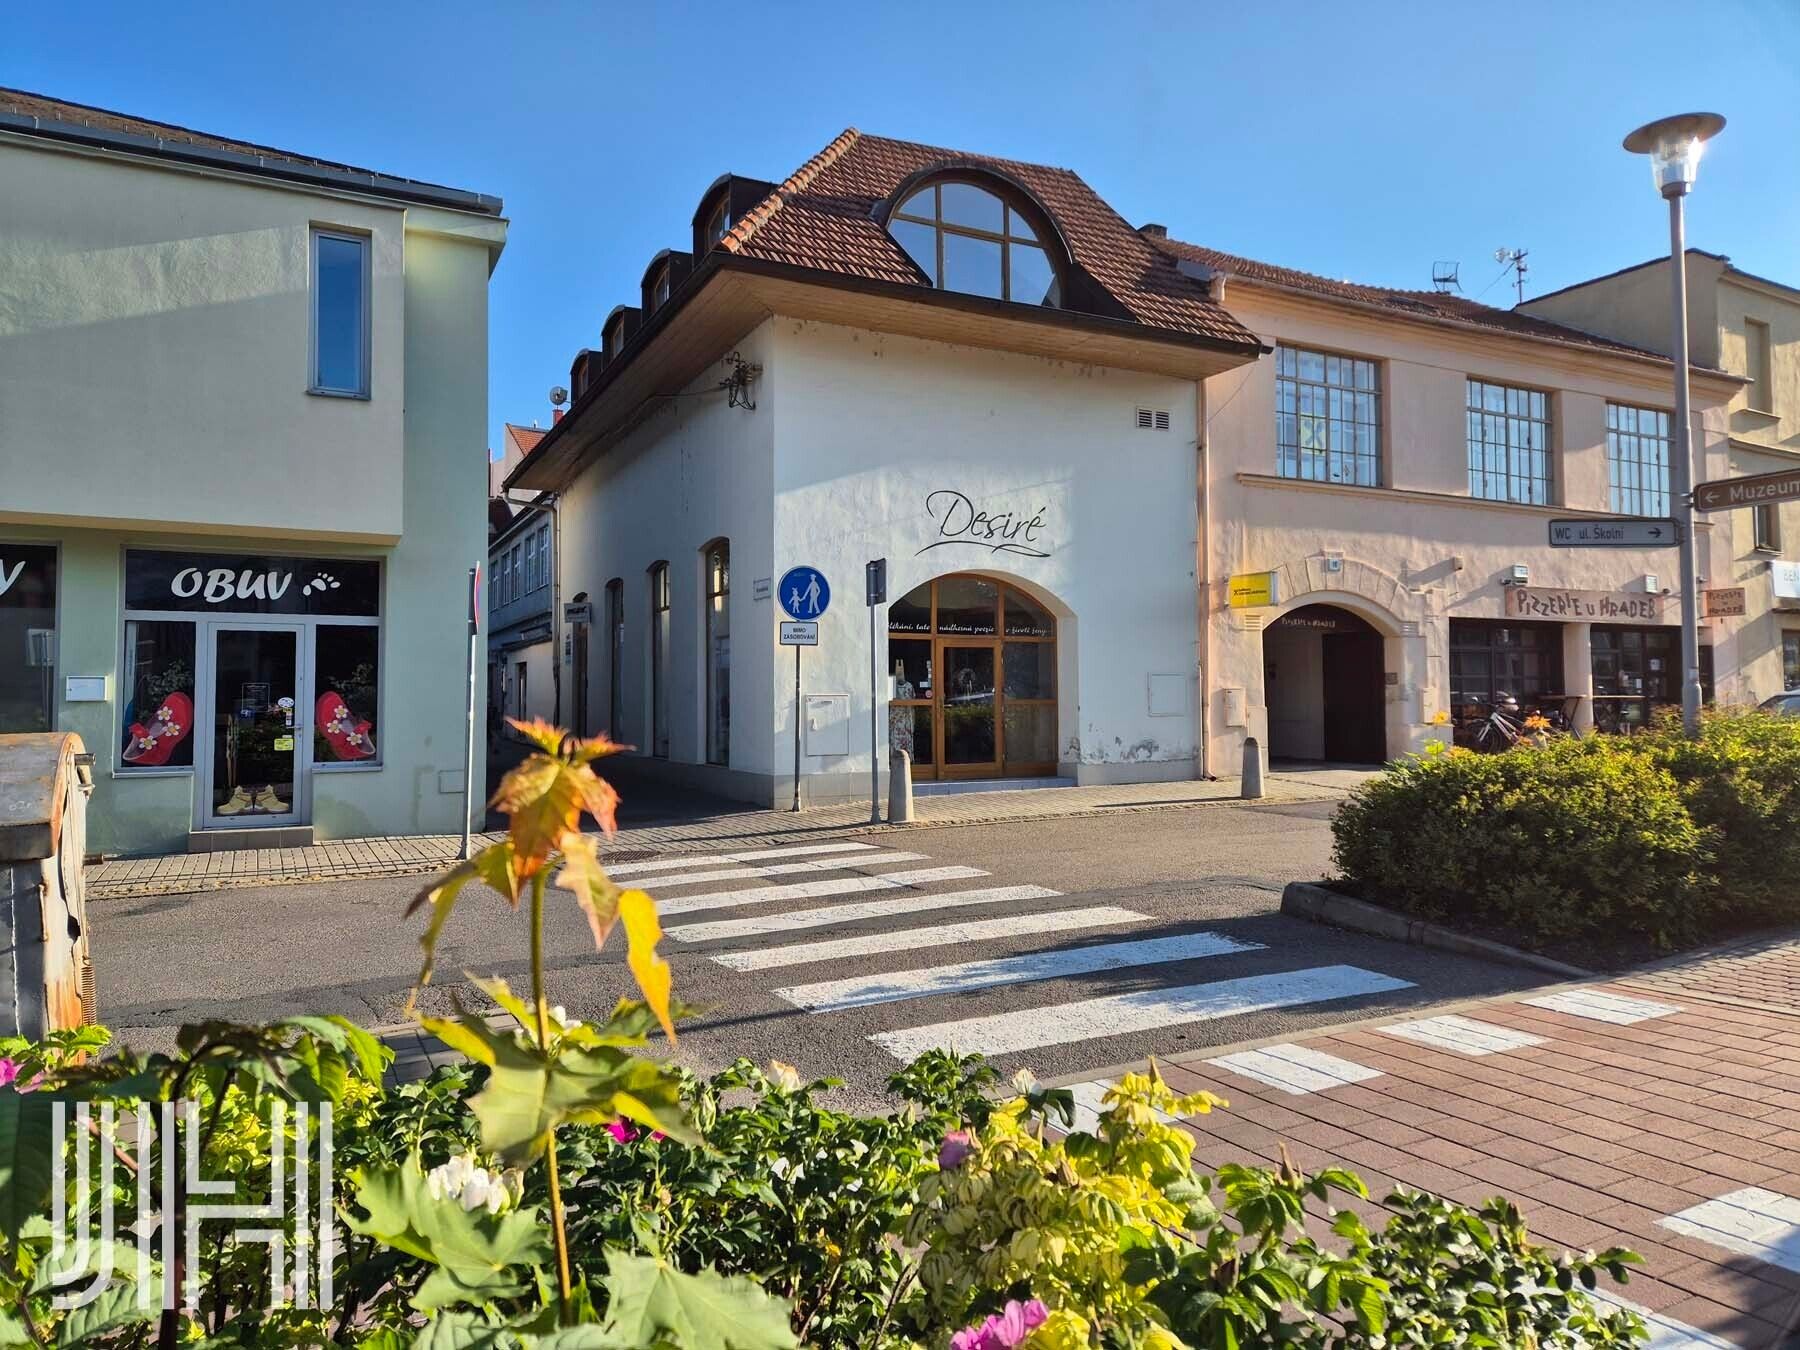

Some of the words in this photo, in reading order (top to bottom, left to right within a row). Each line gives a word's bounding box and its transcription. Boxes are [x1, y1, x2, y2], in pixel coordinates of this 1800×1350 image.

[926, 490, 1047, 542] Desiré
[1554, 527, 1571, 540] WC
[1579, 527, 1592, 540] ul.
[1593, 523, 1625, 540] Školní
[170, 567, 293, 604] OBUV
[1516, 589, 1583, 616] PIZZERIE
[1599, 597, 1657, 619] HRADEB
